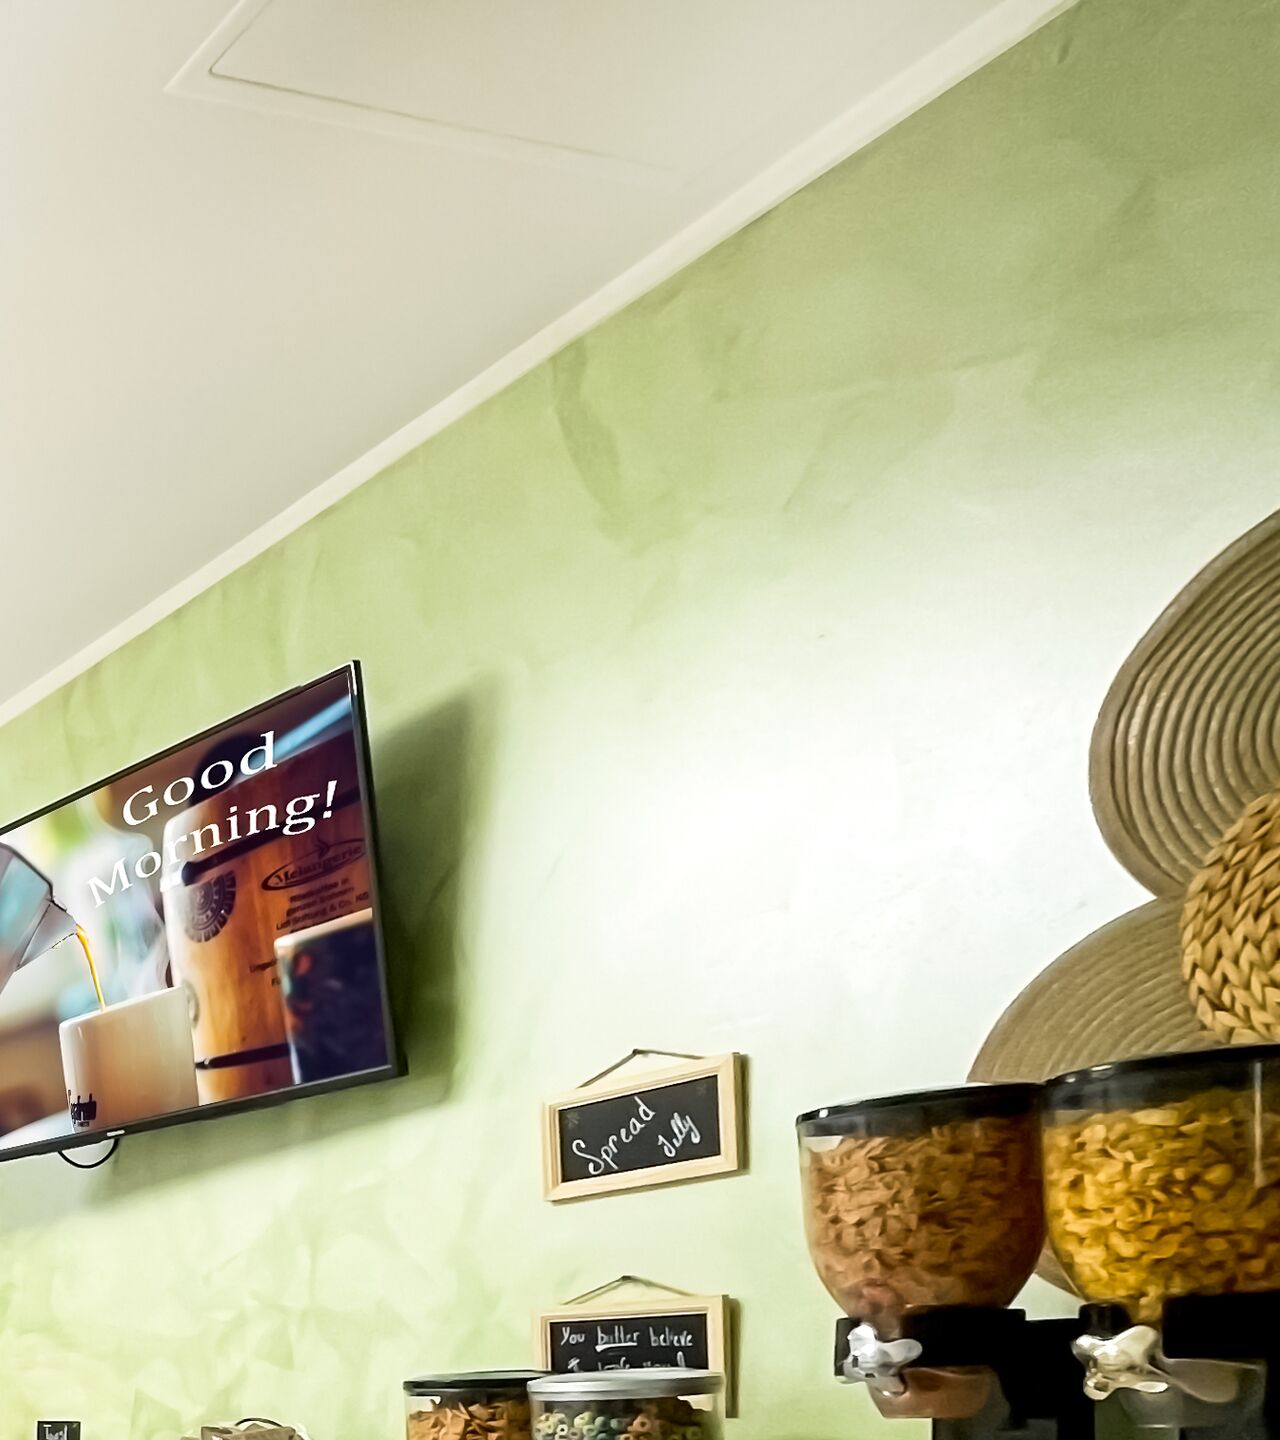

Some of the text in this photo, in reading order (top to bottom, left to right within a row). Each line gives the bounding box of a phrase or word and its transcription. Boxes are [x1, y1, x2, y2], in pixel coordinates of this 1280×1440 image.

[121, 730, 278, 826] Good
[87, 780, 338, 909] Morning!
[571, 1095, 657, 1175] Spread
[560, 1326, 586, 1346] You
[648, 1325, 694, 1347] believe
